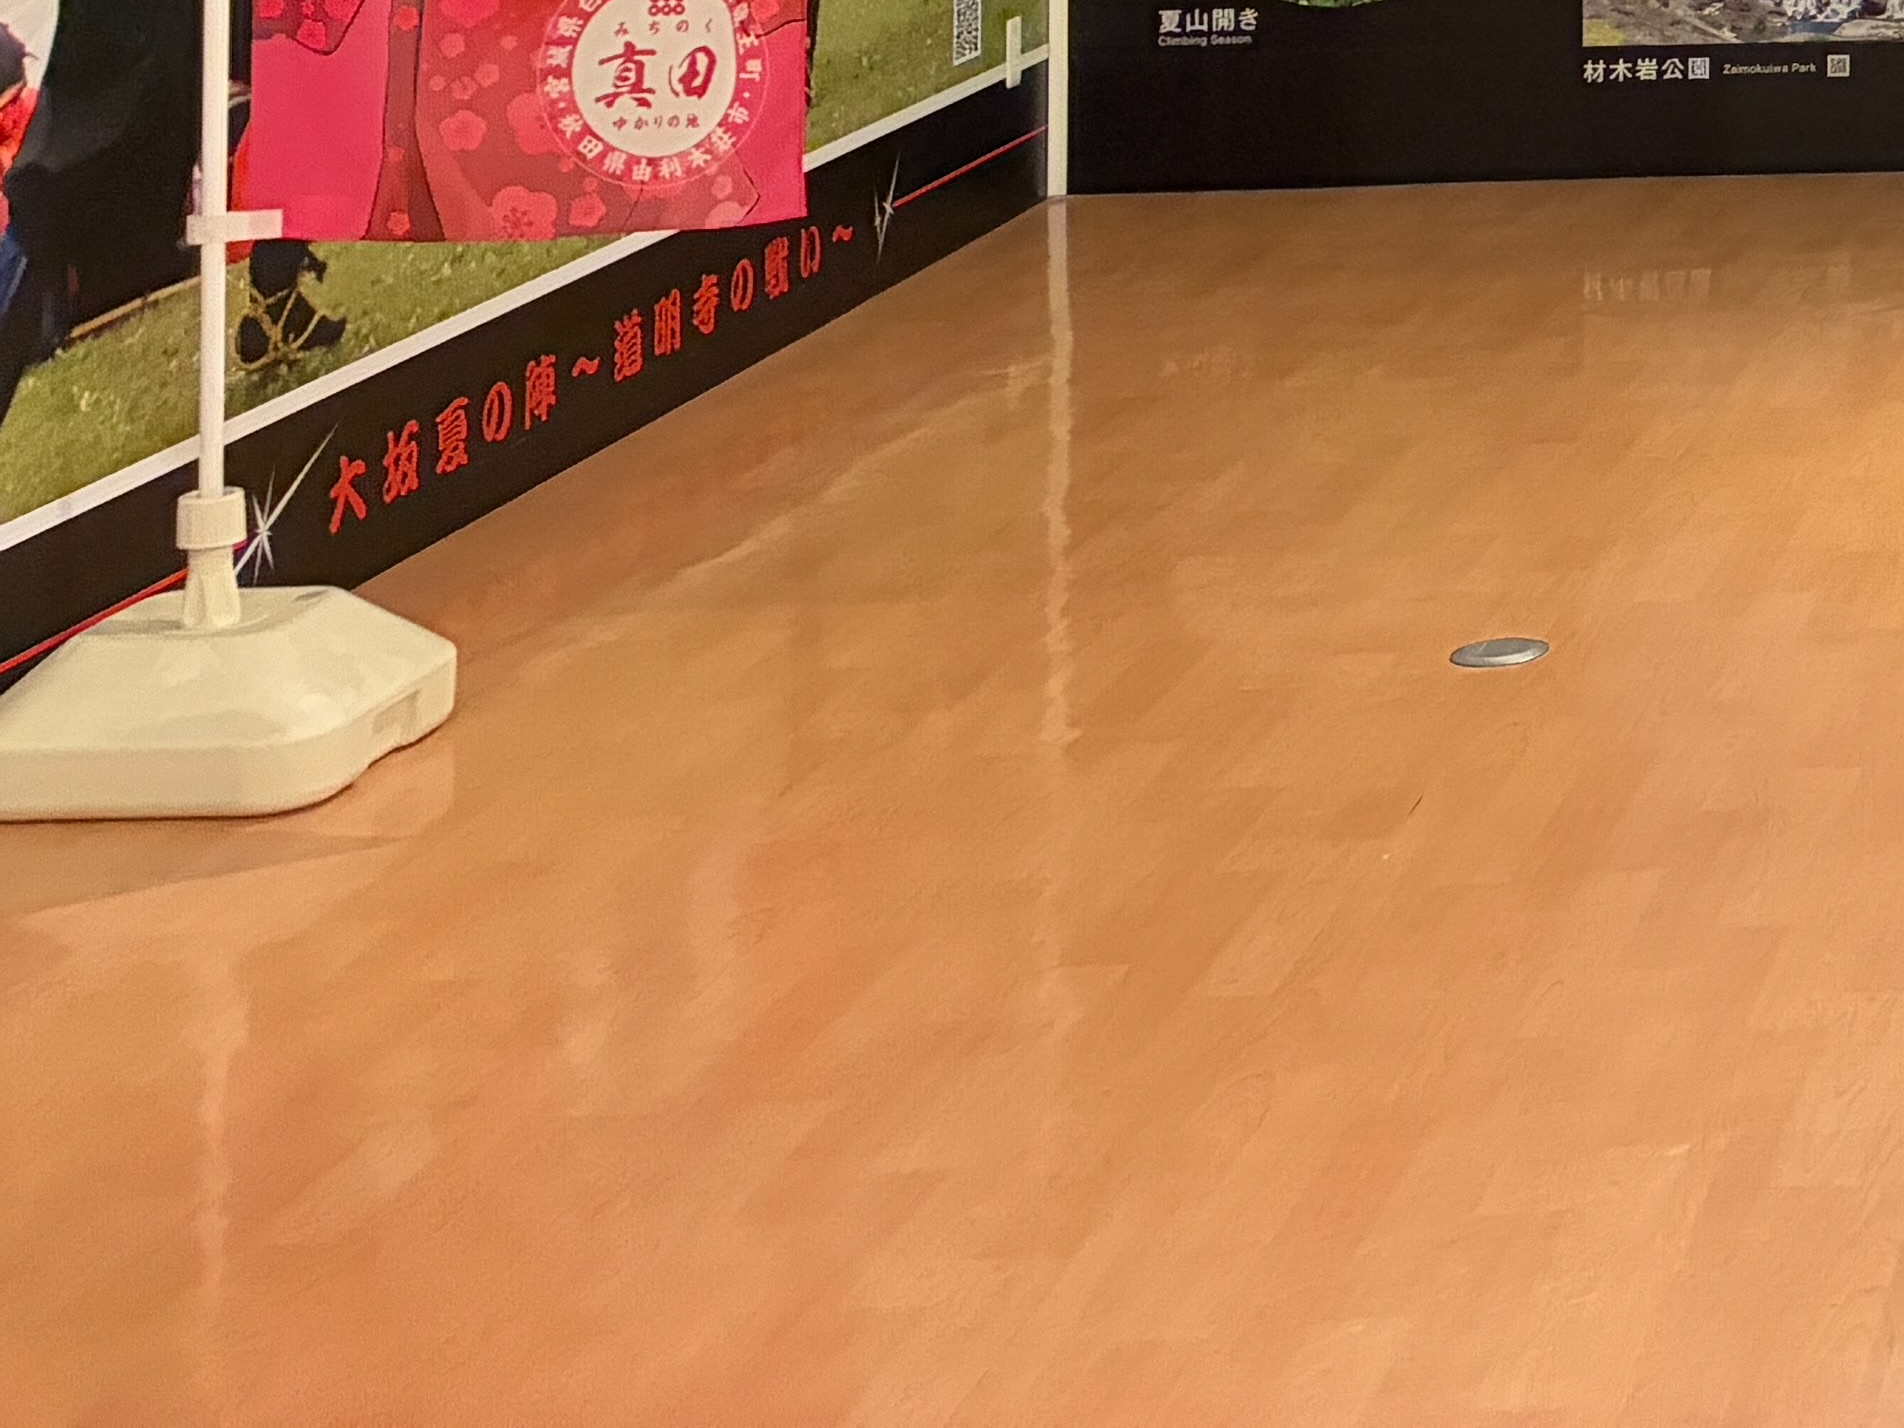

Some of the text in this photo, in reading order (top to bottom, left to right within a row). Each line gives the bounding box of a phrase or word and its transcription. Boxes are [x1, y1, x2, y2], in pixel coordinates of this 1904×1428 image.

[614, 18, 713, 37] みちのく
[1158, 8, 1258, 33] 夏山開き
[595, 40, 717, 109] 真田
[1583, 56, 1710, 83] 材木岩公園
[1791, 62, 1817, 73] Park
